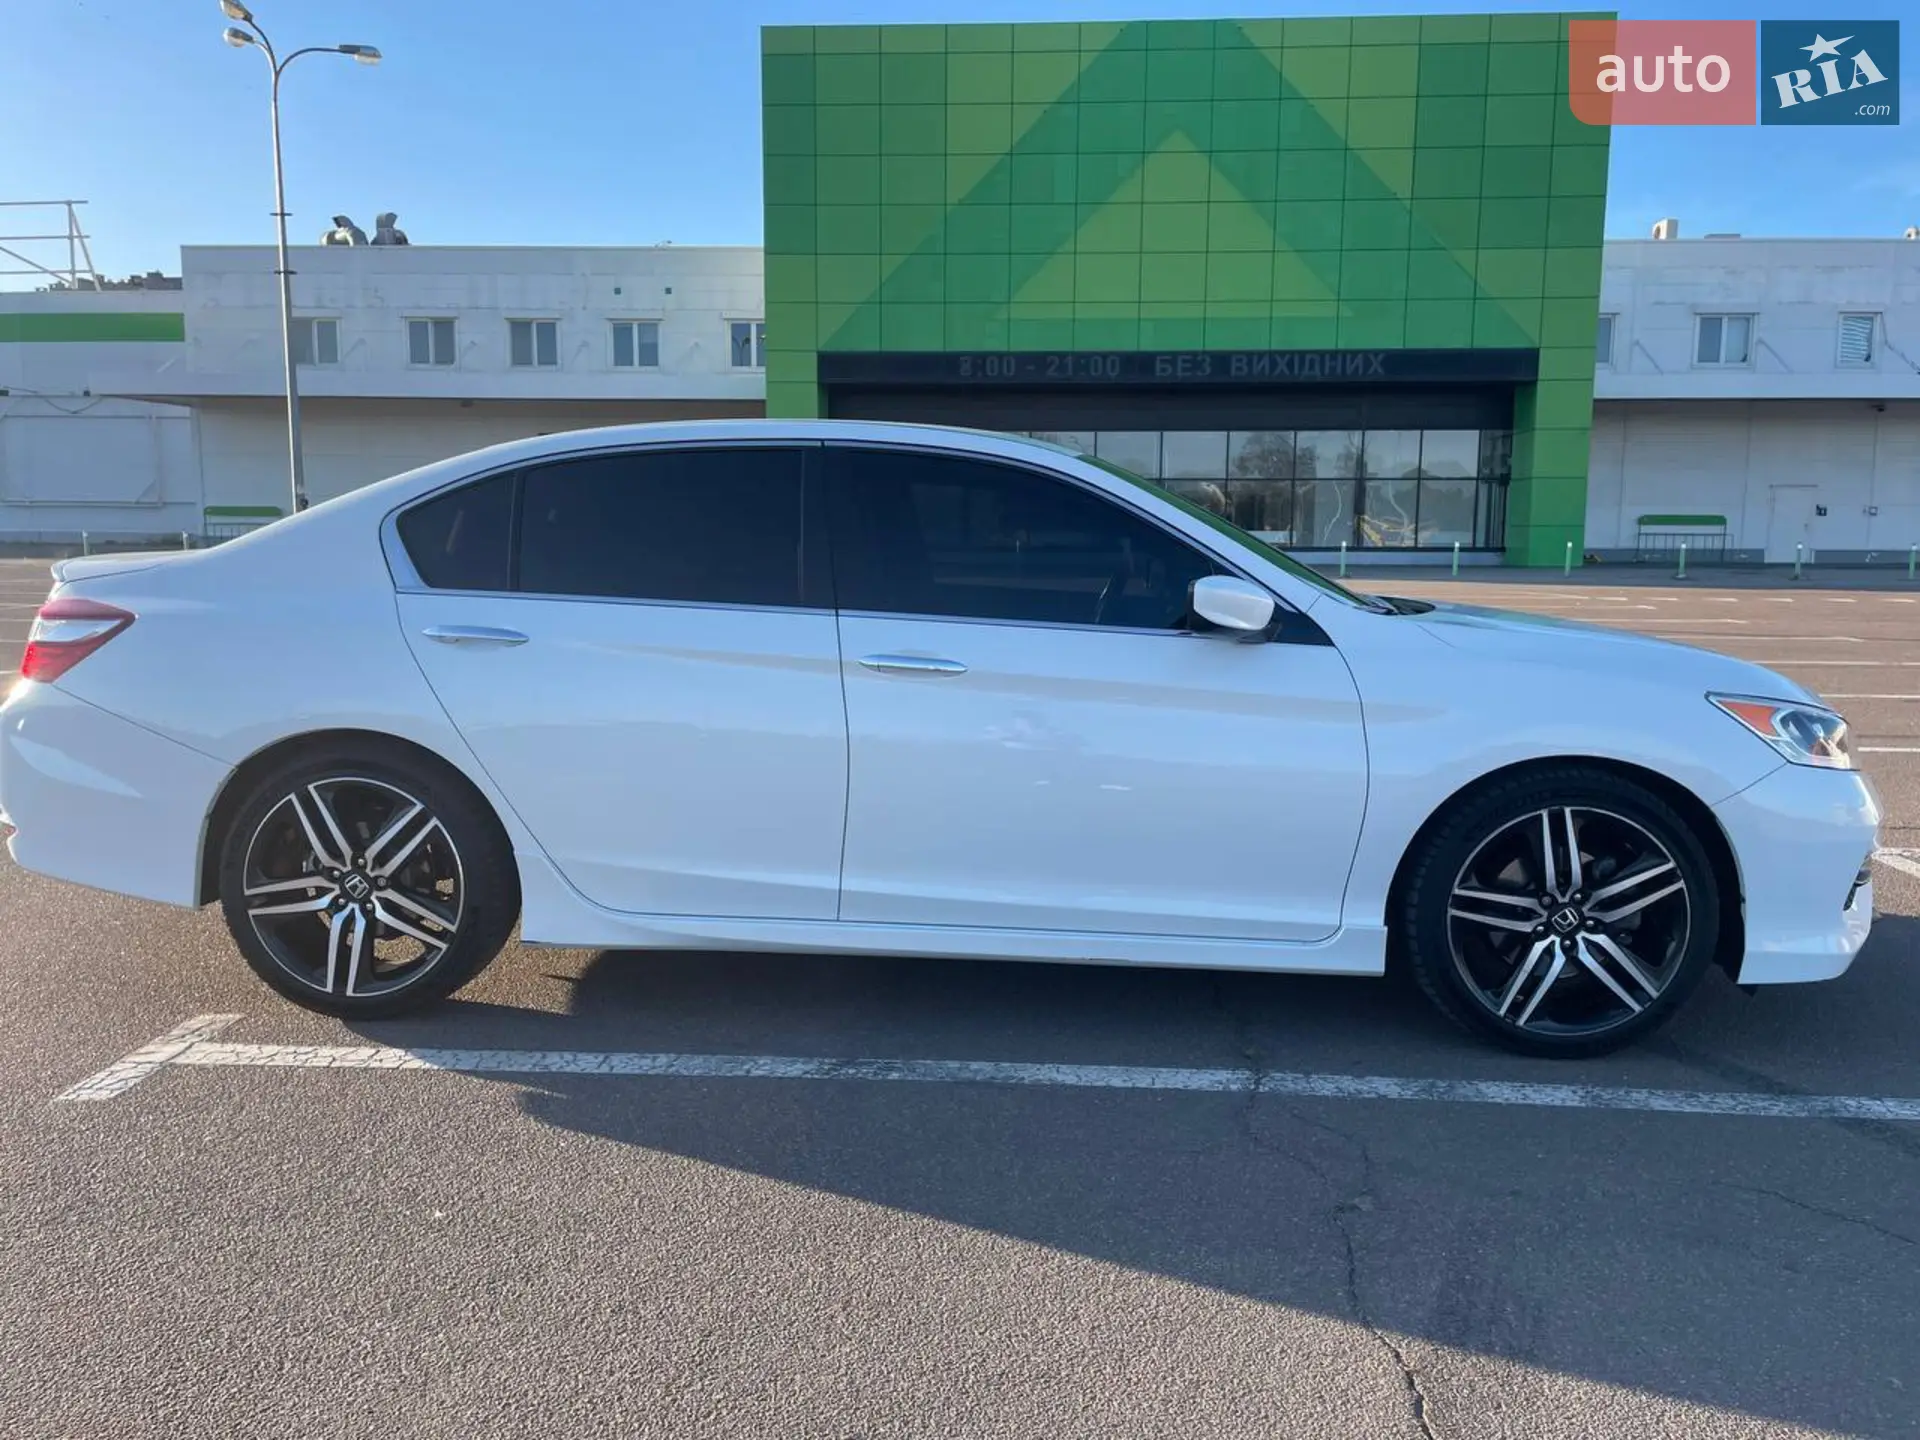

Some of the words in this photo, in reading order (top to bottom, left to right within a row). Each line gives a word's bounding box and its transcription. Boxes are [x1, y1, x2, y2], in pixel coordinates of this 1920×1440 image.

[1046, 354, 1121, 377] 21:00
[1155, 355, 1213, 377] БЕЗ
[1231, 353, 1385, 379] ВИХІДНИХ
